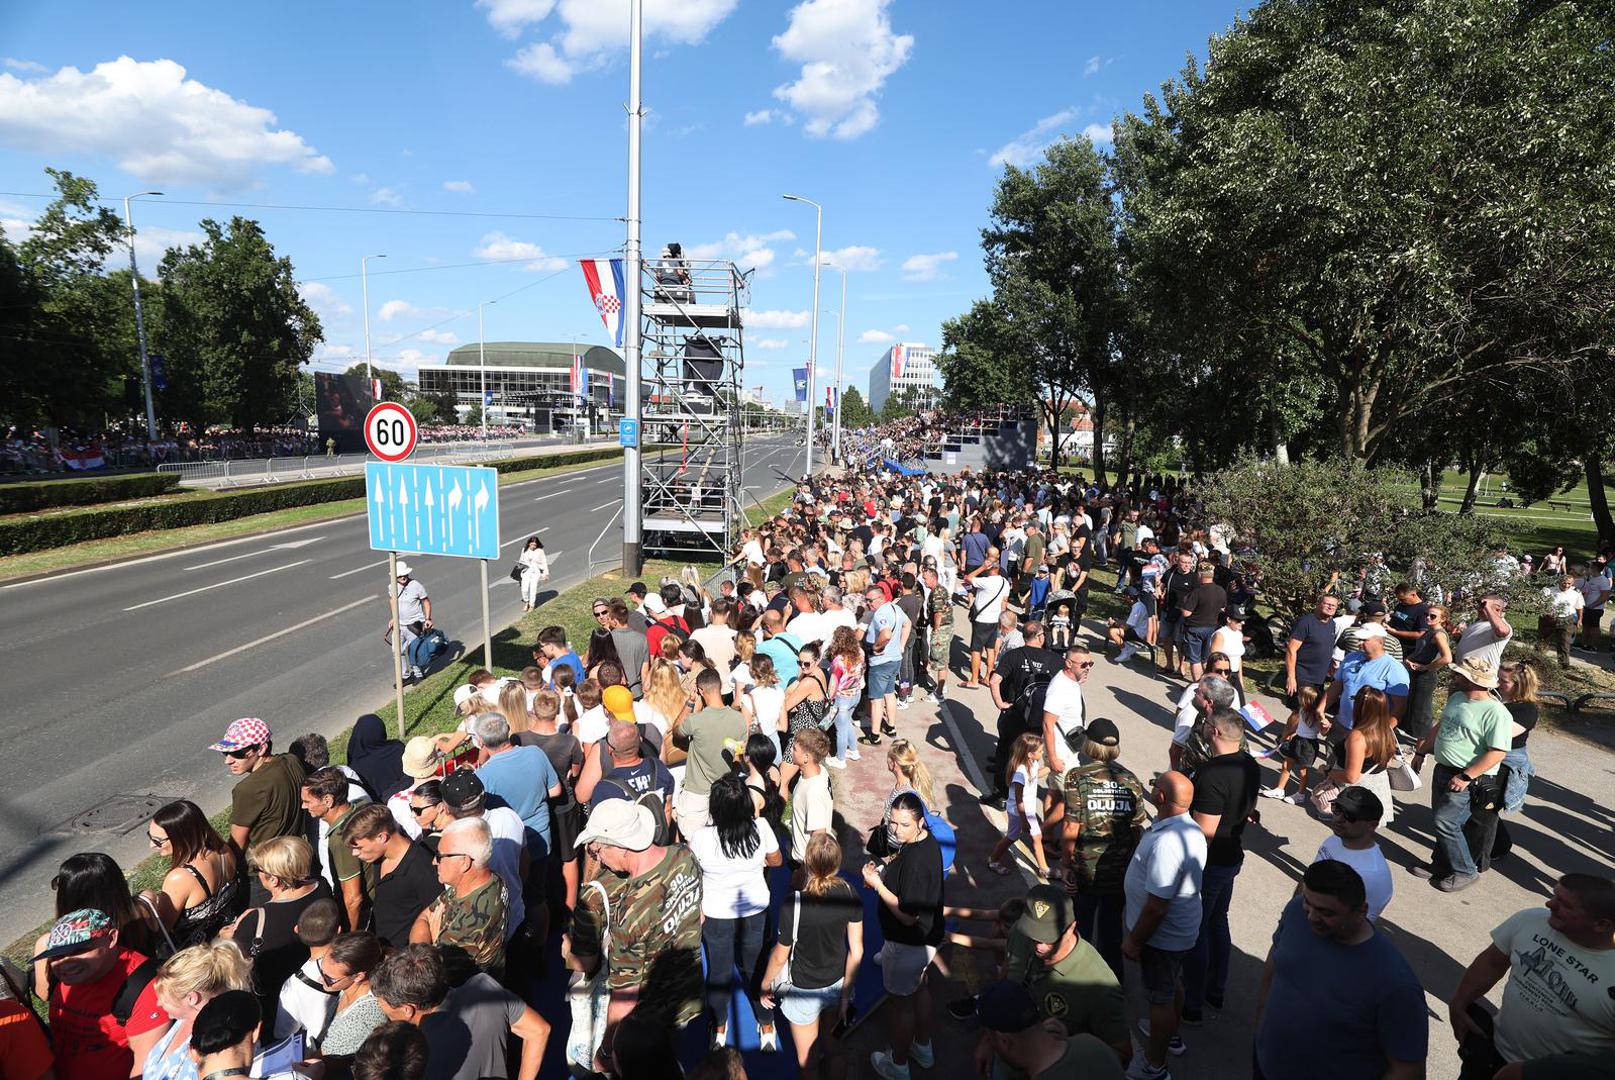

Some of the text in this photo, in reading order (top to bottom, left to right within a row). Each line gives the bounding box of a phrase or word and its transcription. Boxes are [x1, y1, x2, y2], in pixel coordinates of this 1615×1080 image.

[377, 418, 404, 446] 60
[1087, 800, 1131, 811] OLUJA
[670, 872, 688, 892] 30.
[1532, 934, 1567, 958] LONE
[1566, 955, 1599, 984] STAR
